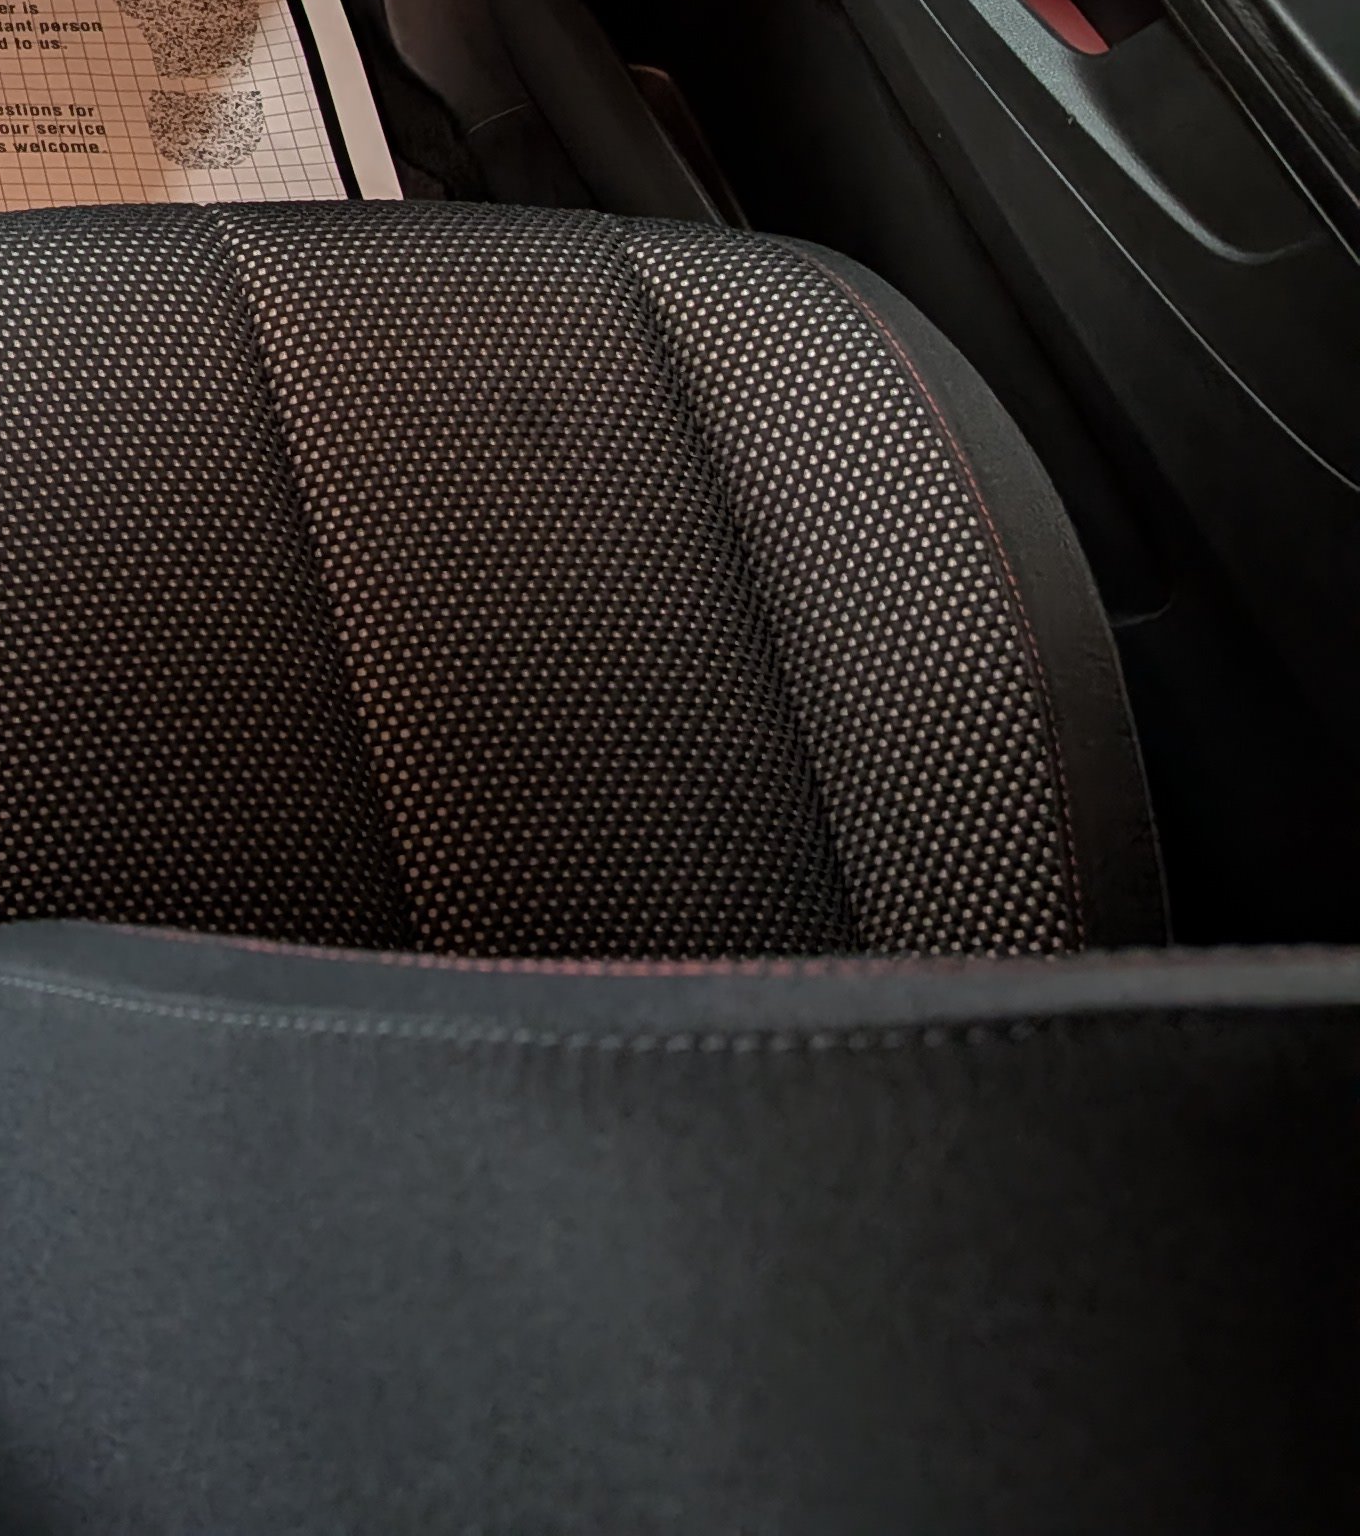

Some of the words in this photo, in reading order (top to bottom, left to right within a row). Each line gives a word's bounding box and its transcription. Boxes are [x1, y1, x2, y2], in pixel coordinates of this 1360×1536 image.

[23, 2, 40, 15] is
[39, 20, 103, 34] person
[15, 37, 32, 50] to
[39, 38, 68, 50] us.
[68, 104, 95, 118] for
[0, 122, 30, 135] our
[36, 121, 106, 136] service
[12, 140, 109, 155] welcome.
